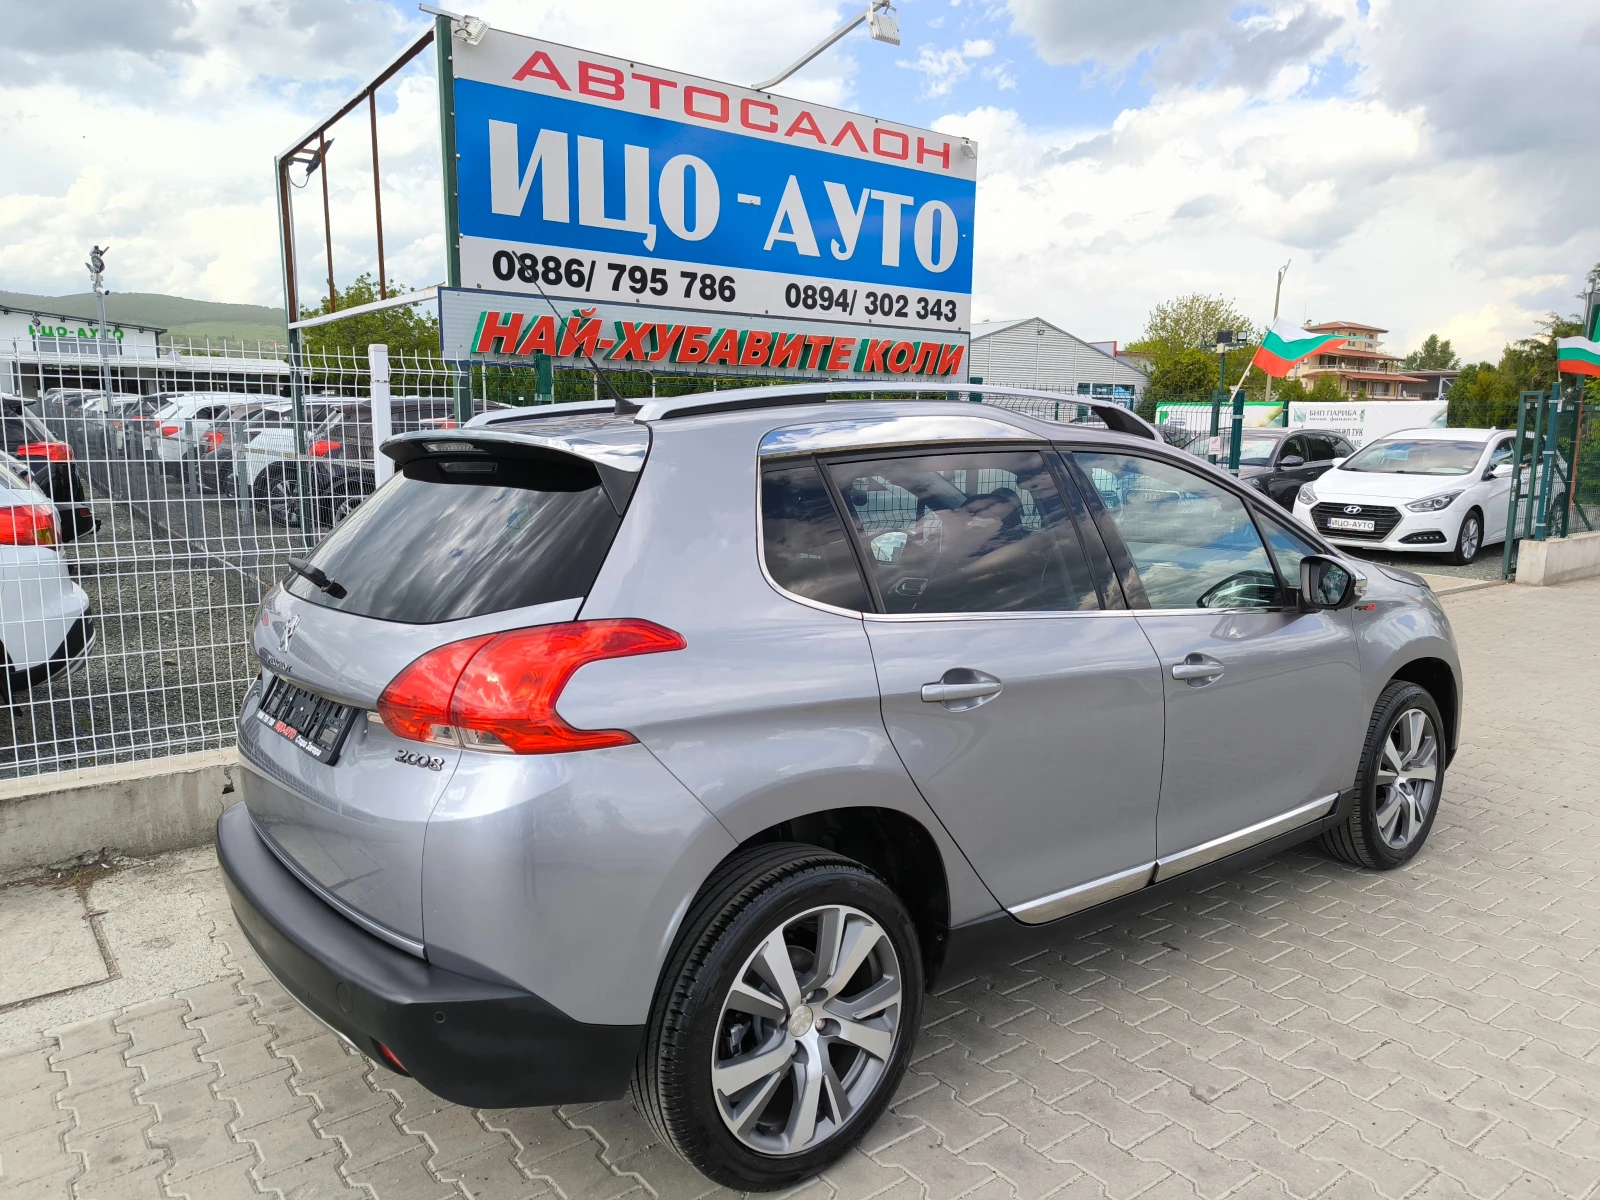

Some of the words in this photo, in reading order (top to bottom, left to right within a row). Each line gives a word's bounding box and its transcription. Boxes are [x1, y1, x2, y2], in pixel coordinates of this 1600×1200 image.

[512, 50, 951, 170] АВТОСАЛОН
[492, 250, 597, 292] 0886/
[607, 263, 668, 296] 795
[680, 271, 736, 303] 786
[784, 282, 858, 316] 0894/
[864, 291, 909, 318] 302
[916, 297, 957, 322] 343
[856, 338, 965, 376] КОЛИ
[1326, 409, 1357, 417] ПАРИБА
[1331, 518, 1374, 530] ИЦО-АУТО
[394, 749, 445, 771] 2008
